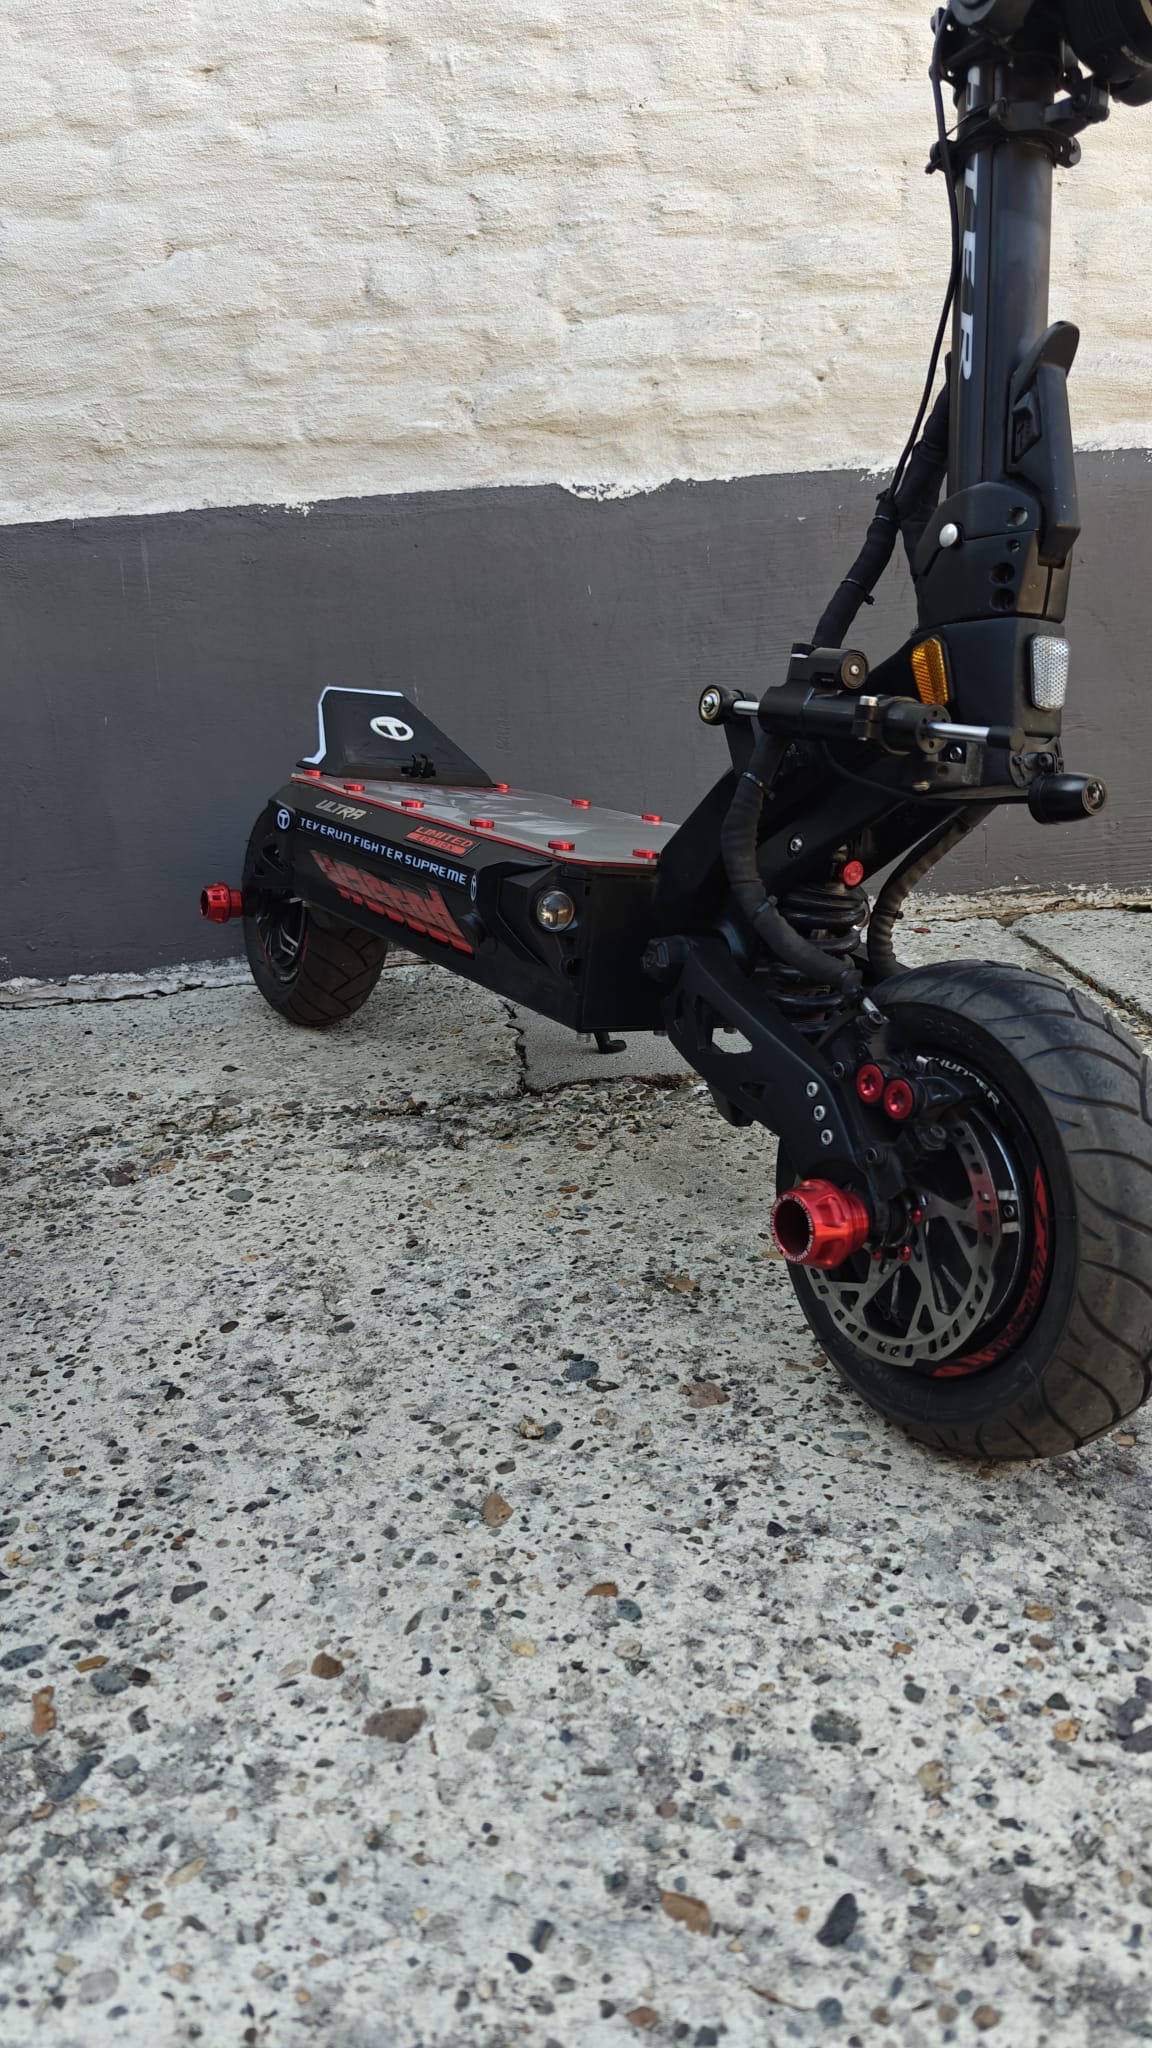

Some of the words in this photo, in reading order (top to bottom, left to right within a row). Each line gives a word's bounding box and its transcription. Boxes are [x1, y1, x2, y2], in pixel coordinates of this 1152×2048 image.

[315, 799, 367, 821] ULTRA
[415, 826, 474, 848] LIMITED
[300, 817, 352, 843] TEVERUN
[353, 836, 403, 863] FIGHTER
[405, 855, 468, 885] SUPREME
